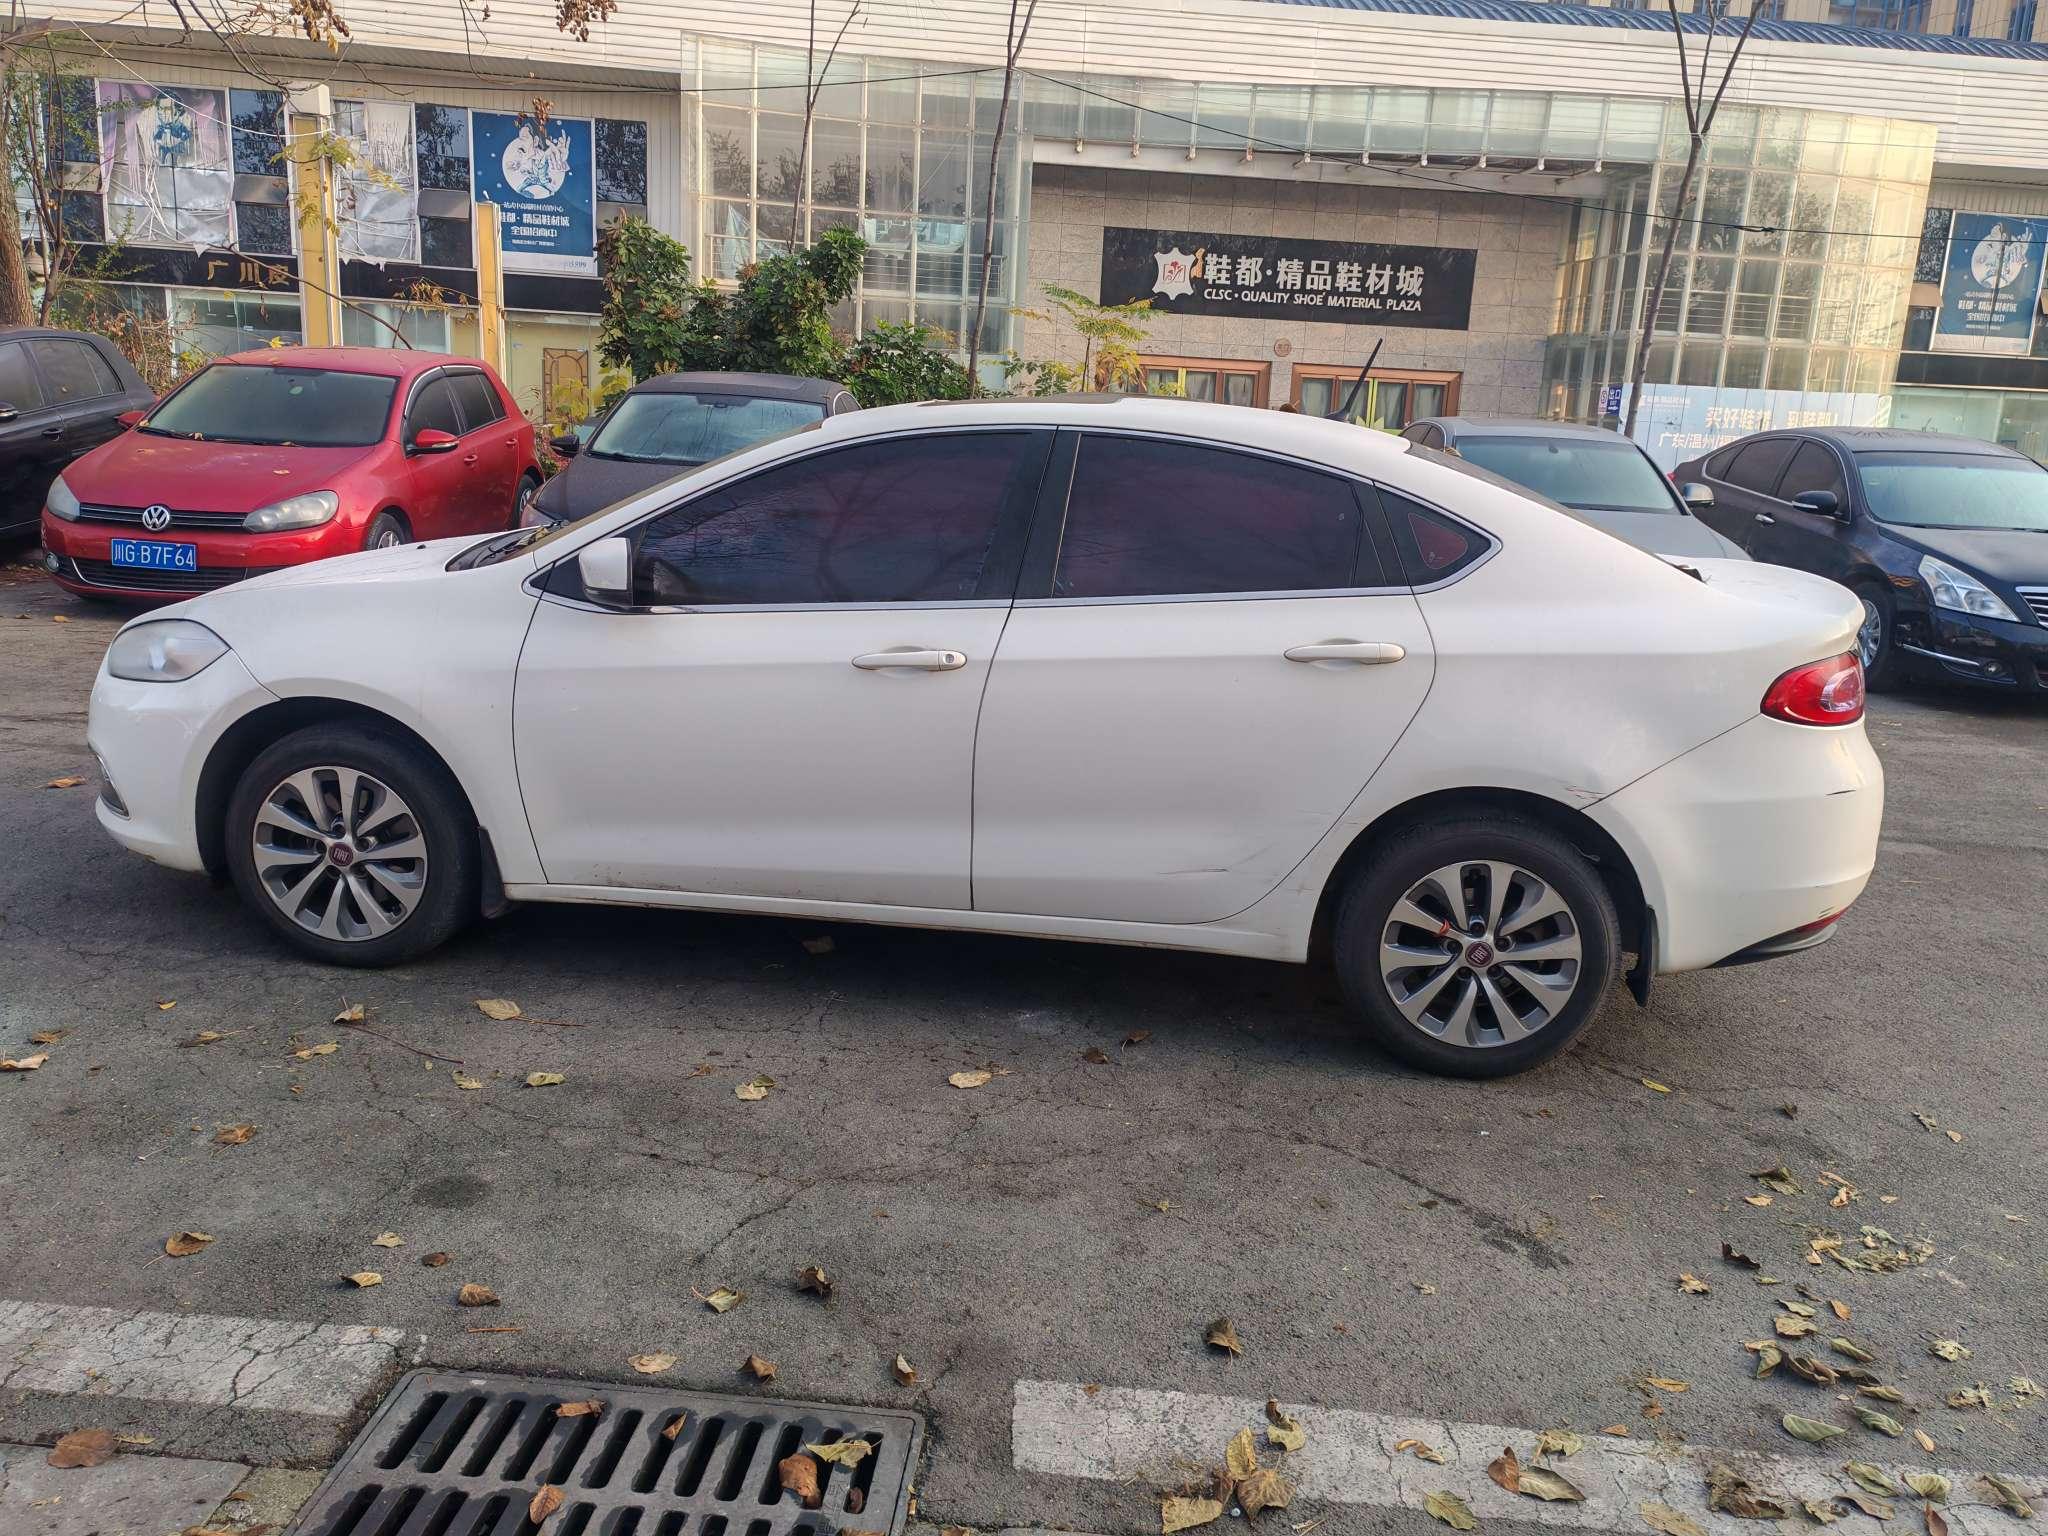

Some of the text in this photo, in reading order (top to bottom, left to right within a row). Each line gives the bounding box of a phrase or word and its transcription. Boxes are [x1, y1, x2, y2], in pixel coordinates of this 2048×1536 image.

[1204, 253, 1424, 296] 鞋都·精品鞋材城
[1293, 293, 1323, 305] SHOE
[1327, 295, 1382, 309] MATERIAL
[1386, 299, 1422, 311] PLAZA
